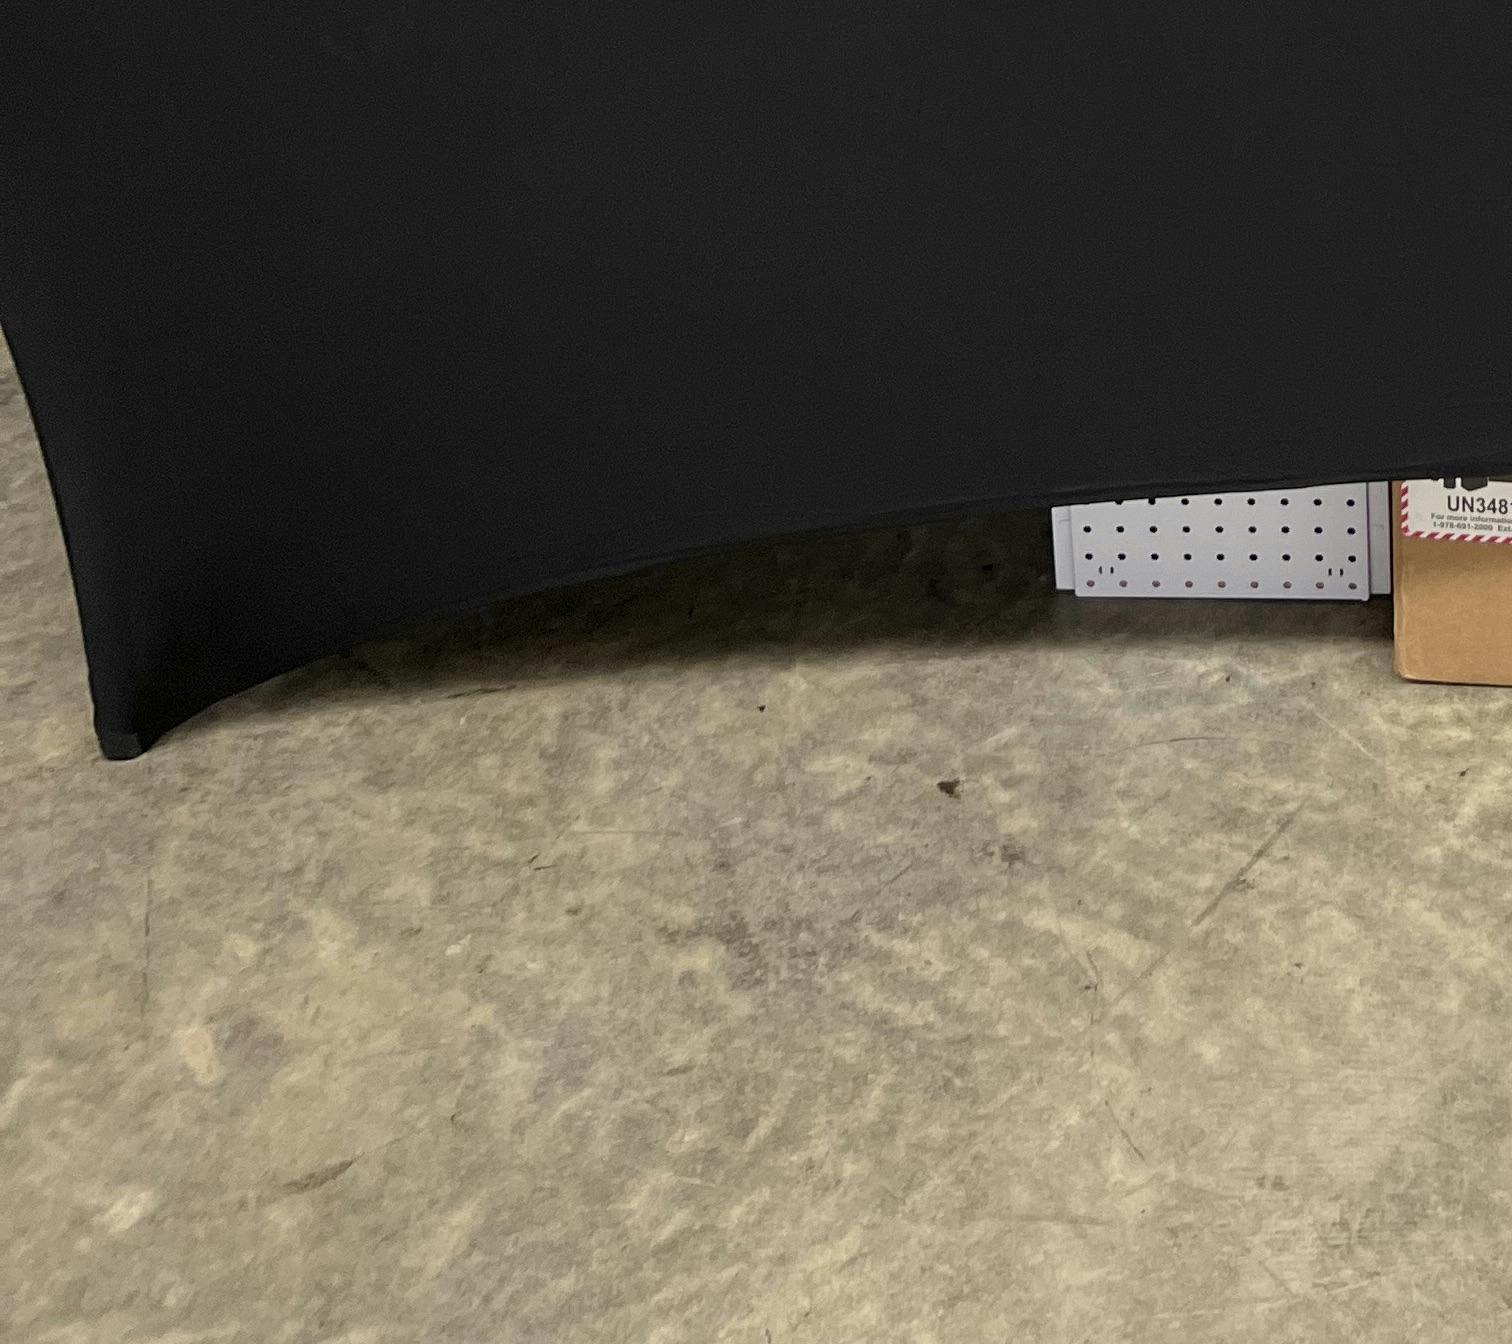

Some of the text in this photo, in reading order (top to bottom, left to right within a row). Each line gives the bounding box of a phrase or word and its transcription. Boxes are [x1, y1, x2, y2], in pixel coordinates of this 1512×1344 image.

[1431, 512, 1445, 520] For
[1447, 514, 1468, 522] more
[1498, 525, 1512, 533] Ext.
